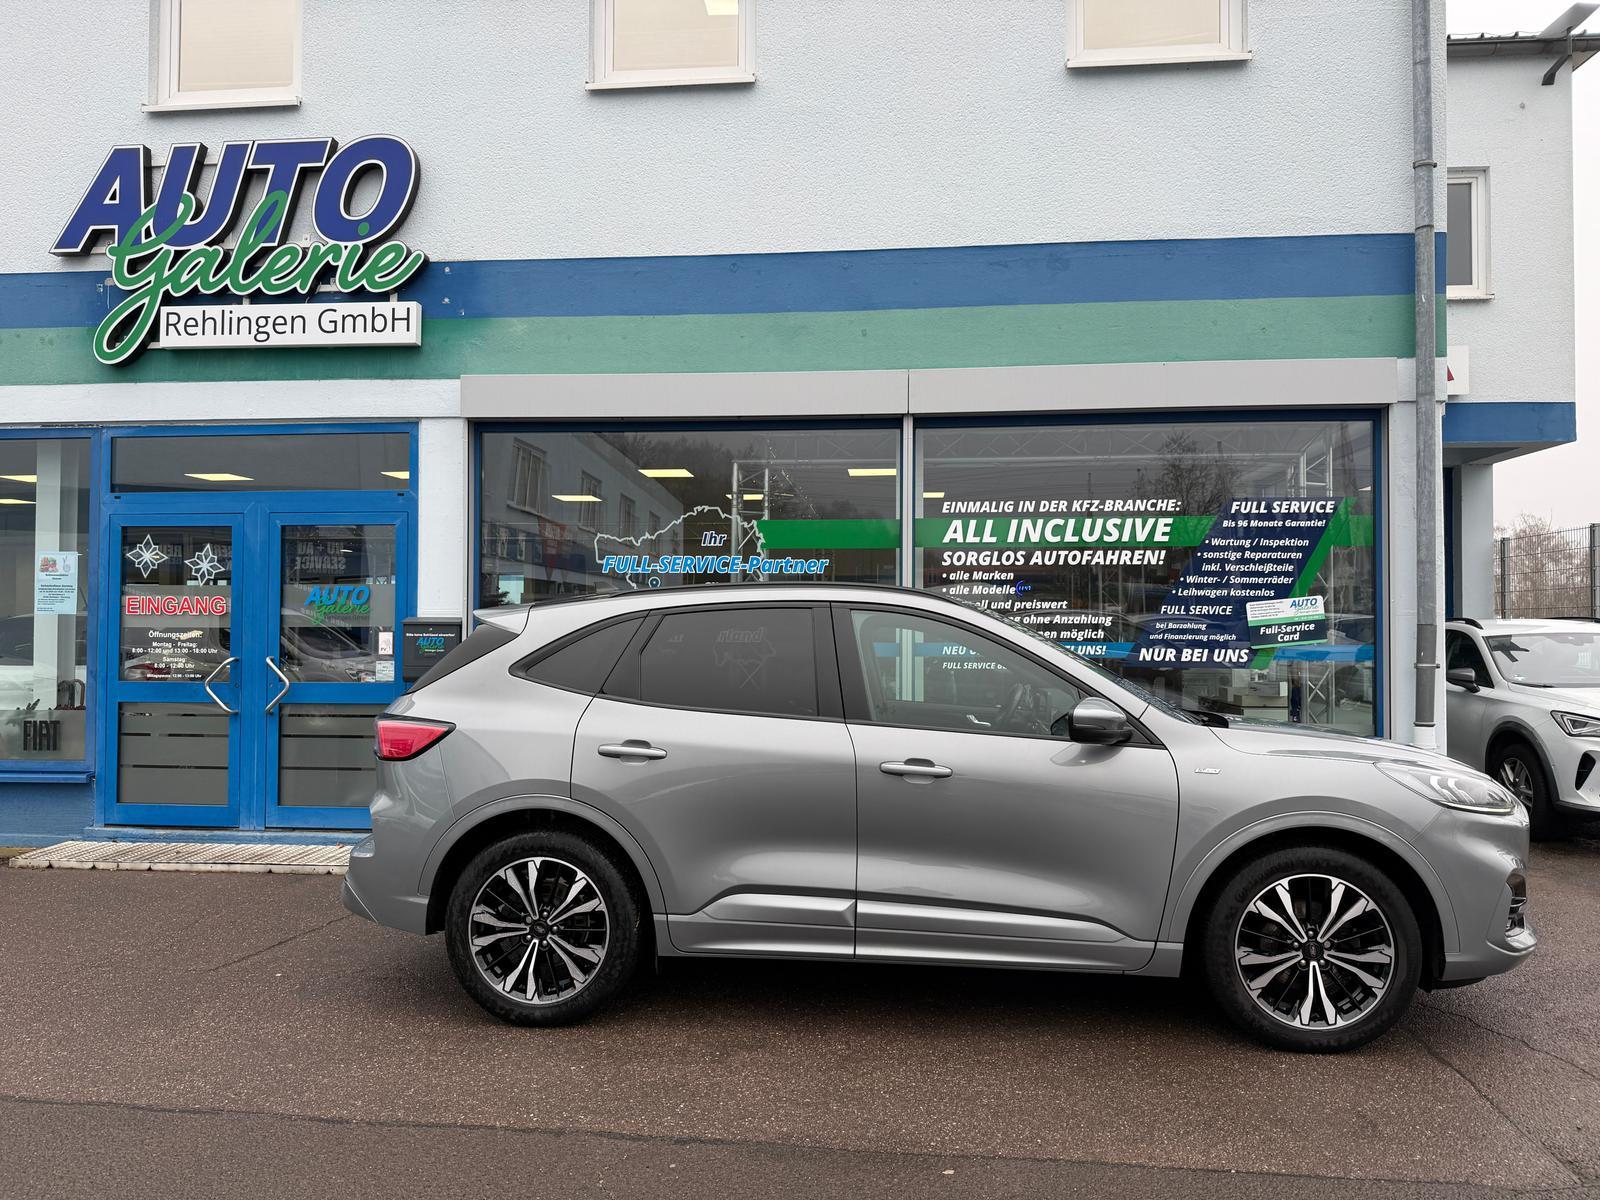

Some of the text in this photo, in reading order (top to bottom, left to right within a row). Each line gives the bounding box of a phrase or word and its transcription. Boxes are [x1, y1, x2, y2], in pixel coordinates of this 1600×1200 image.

[49, 133, 421, 256] AUTO
[93, 190, 428, 365] Galerie
[165, 307, 412, 342] Rehlingen GmbH
[942, 499, 1182, 513] EINMALIG IN DER KFZ-BRANCHE:
[1231, 501, 1335, 514] FULL SERVICE
[1222, 519, 1326, 528] Bis 96 Monate Garantie!
[942, 517, 1174, 543] ALL INCLUSIVE
[701, 531, 728, 547] Ihr
[1211, 538, 1251, 548] Wartung
[1260, 538, 1309, 548] Inspektion
[942, 550, 1167, 566] SORGLOS AUTOFAHREN!
[1203, 550, 1302, 561] sonstige Reparaturen
[602, 556, 829, 574] FULL-SERVICE-Partner
[1202, 562, 1294, 573] inkl. Verschleißteile
[949, 571, 1014, 580] alle Marken
[1186, 575, 1221, 584] Winter-
[1229, 575, 1294, 584] Sommerräder
[304, 585, 370, 606] AUTO
[949, 585, 969, 595] alle
[972, 585, 1016, 595] Modelle
[1178, 587, 1275, 598] Leihwagen kostenlos
[126, 595, 227, 616] EINGANG
[991, 600, 1011, 609] und
[1013, 600, 1068, 612] preiswert
[1290, 598, 1317, 608] AUTO
[1160, 606, 1233, 615] FULL SERVICE
[1023, 614, 1050, 624] ohne
[1053, 614, 1113, 626] Anzahlung
[1168, 622, 1206, 631] Barzahlung
[1260, 623, 1315, 635] Full-Service
[416, 637, 445, 645] AUTO
[1060, 629, 1104, 641] möglich
[1164, 633, 1208, 642] Finanzierung
[1209, 633, 1237, 642] möglich
[1277, 632, 1300, 642] Card
[943, 645, 967, 655] NEU
[1077, 645, 1107, 655] UNS!
[1139, 648, 1249, 662] NUR BEI UNS
[23, 720, 61, 751] FIAT
